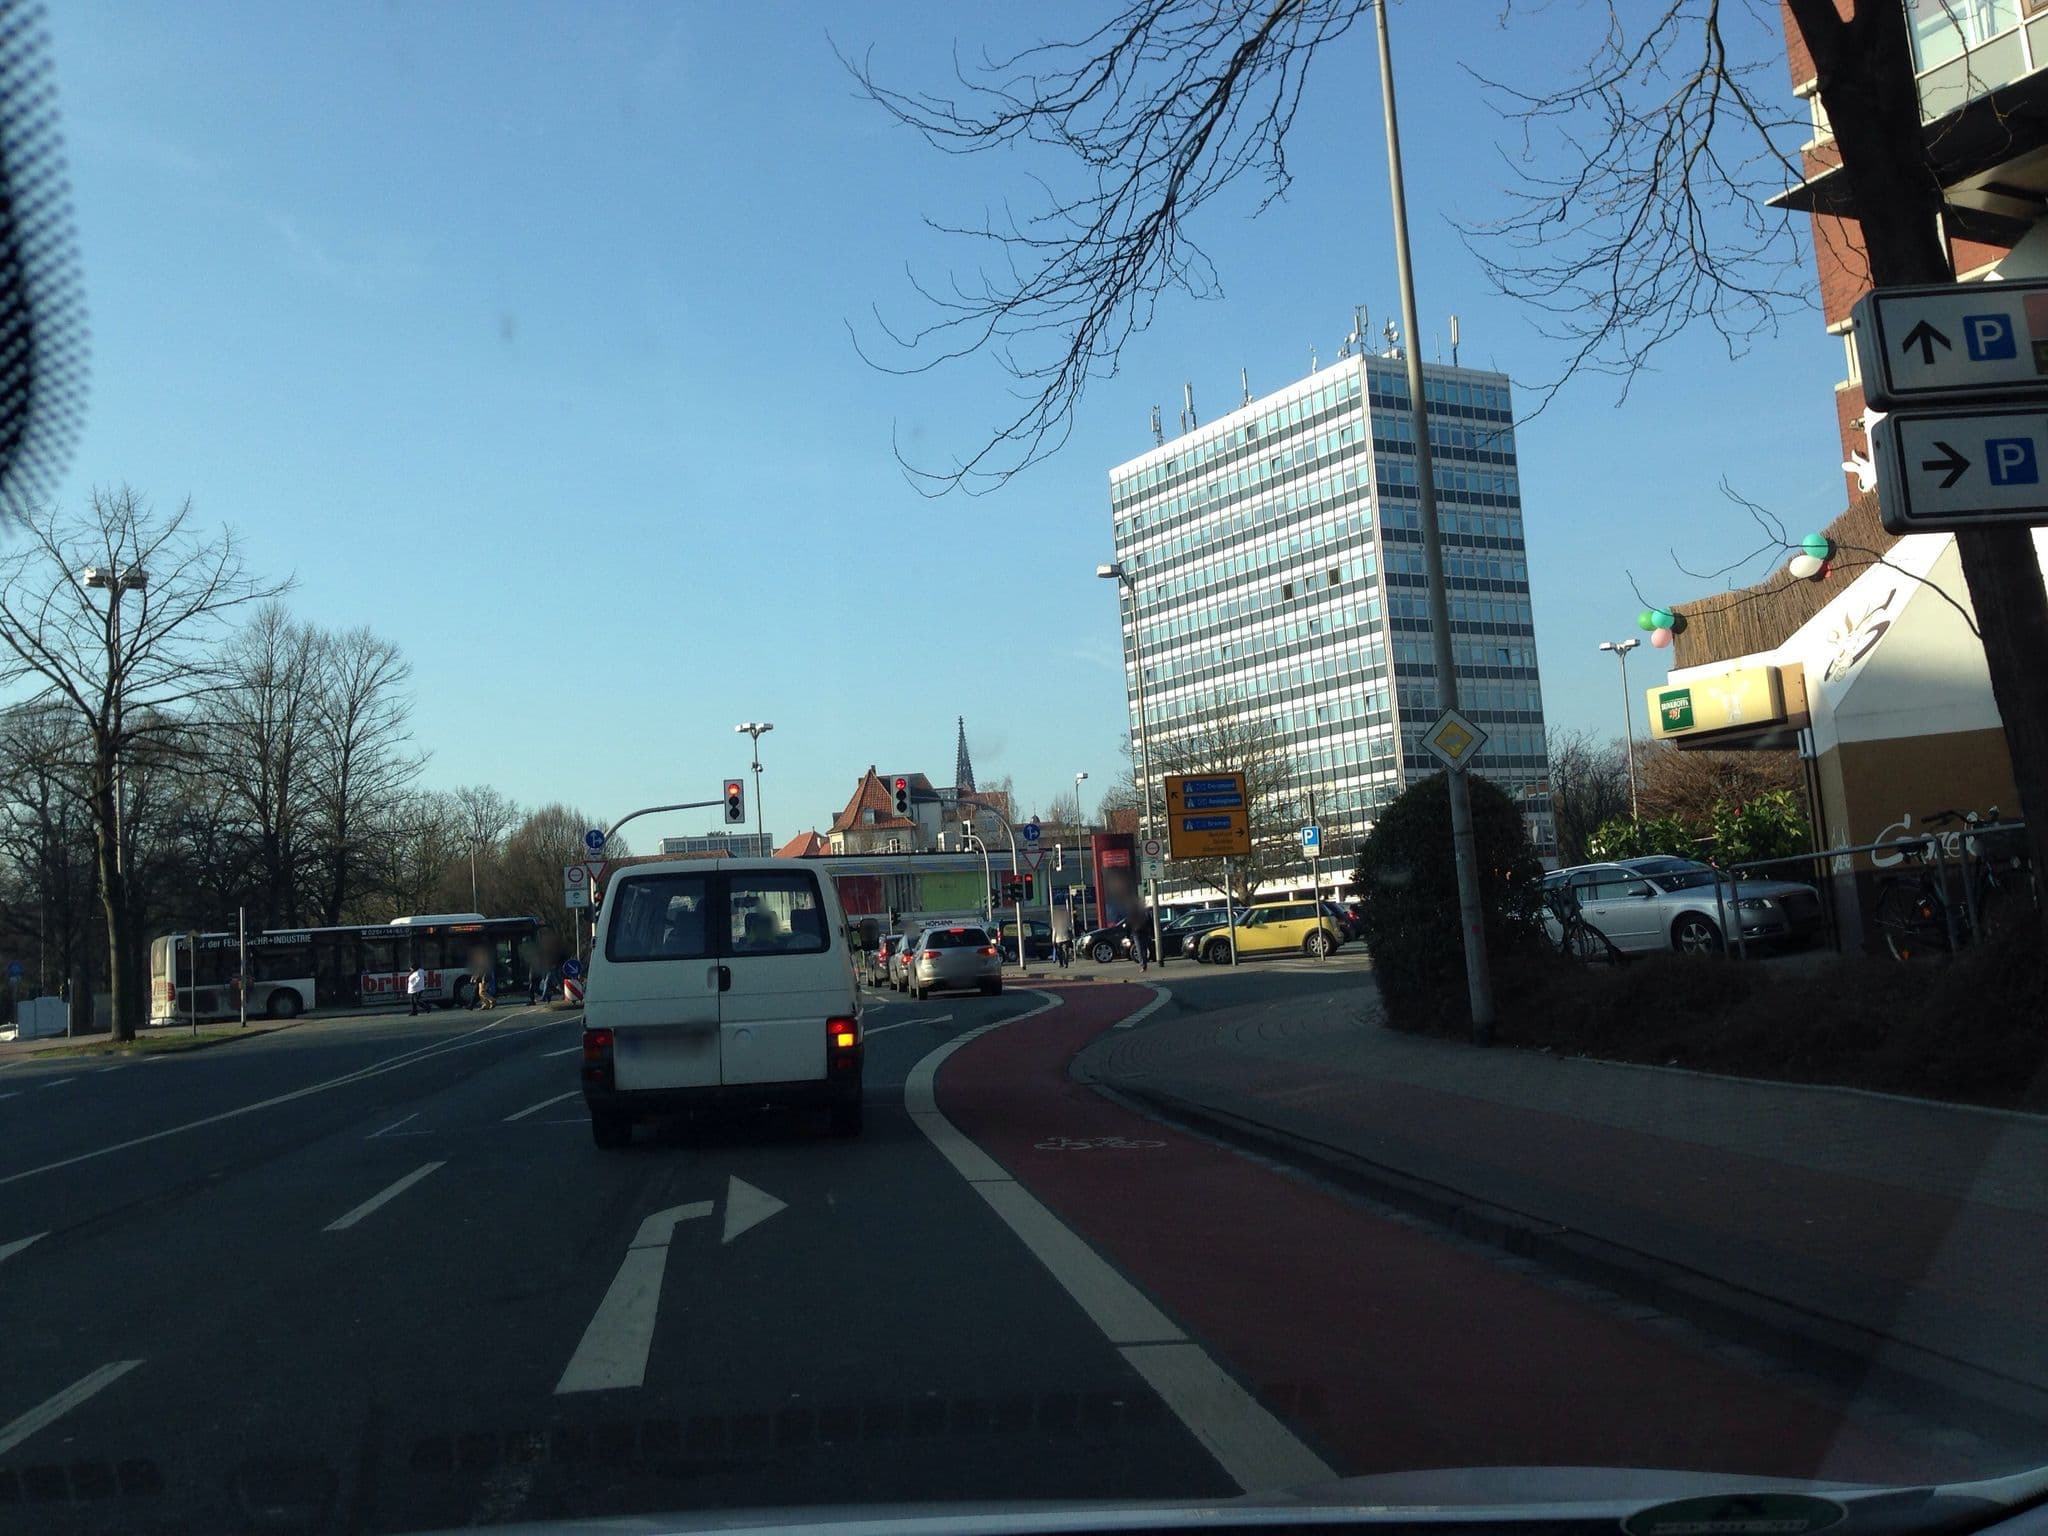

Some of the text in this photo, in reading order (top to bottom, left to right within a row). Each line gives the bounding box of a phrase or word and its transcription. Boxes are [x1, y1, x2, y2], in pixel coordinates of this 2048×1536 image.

[1974, 319, 2003, 356] P
[1996, 443, 2025, 481] P
[1303, 829, 1314, 844] P
